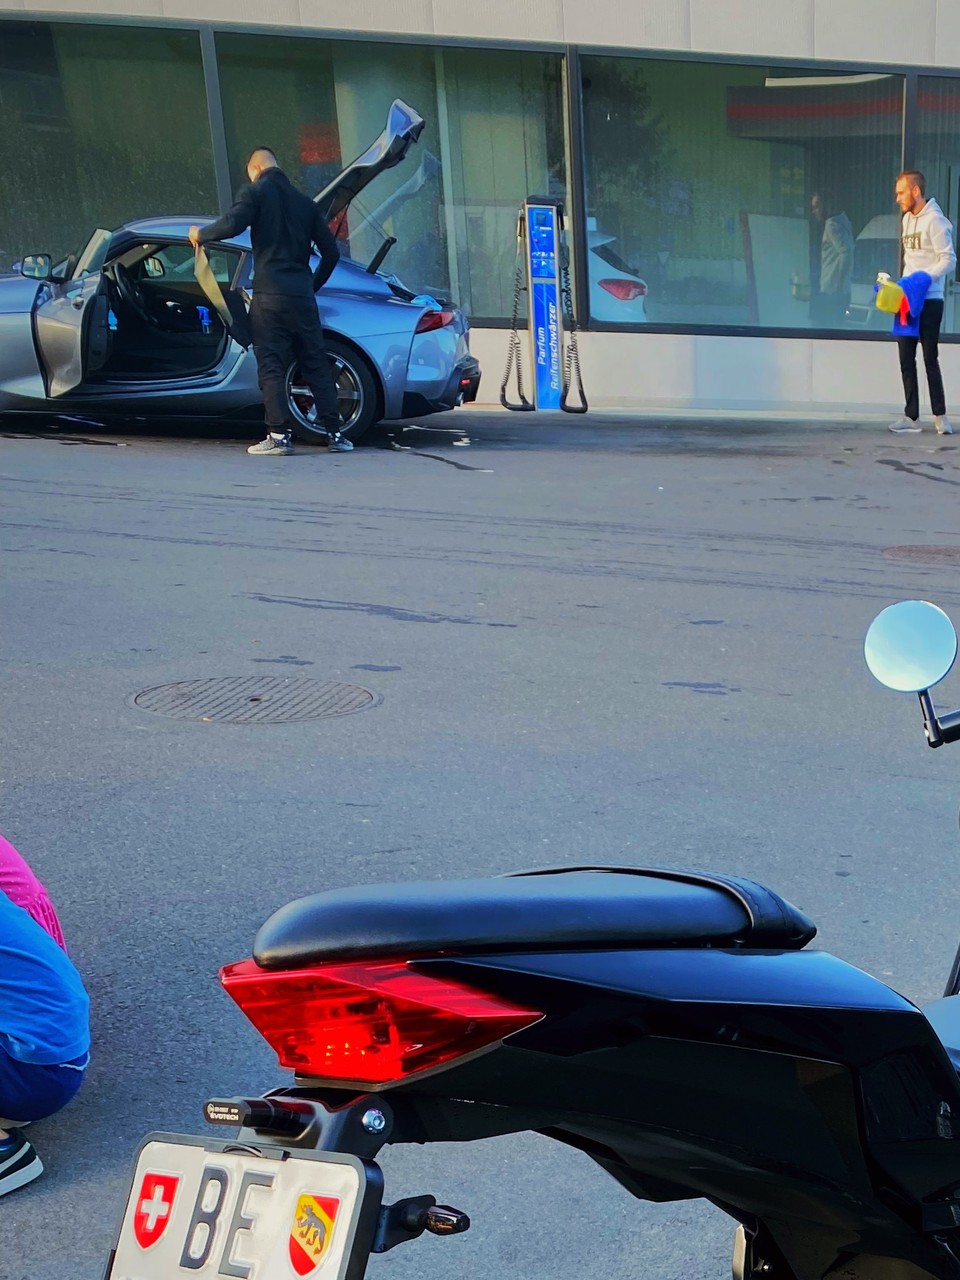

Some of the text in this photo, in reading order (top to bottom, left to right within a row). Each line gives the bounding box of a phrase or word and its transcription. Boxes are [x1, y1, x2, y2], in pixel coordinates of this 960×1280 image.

[537, 327, 546, 365] Parfum
[548, 302, 559, 390] Reifenschwärzer
[179, 1164, 275, 1280] BE
